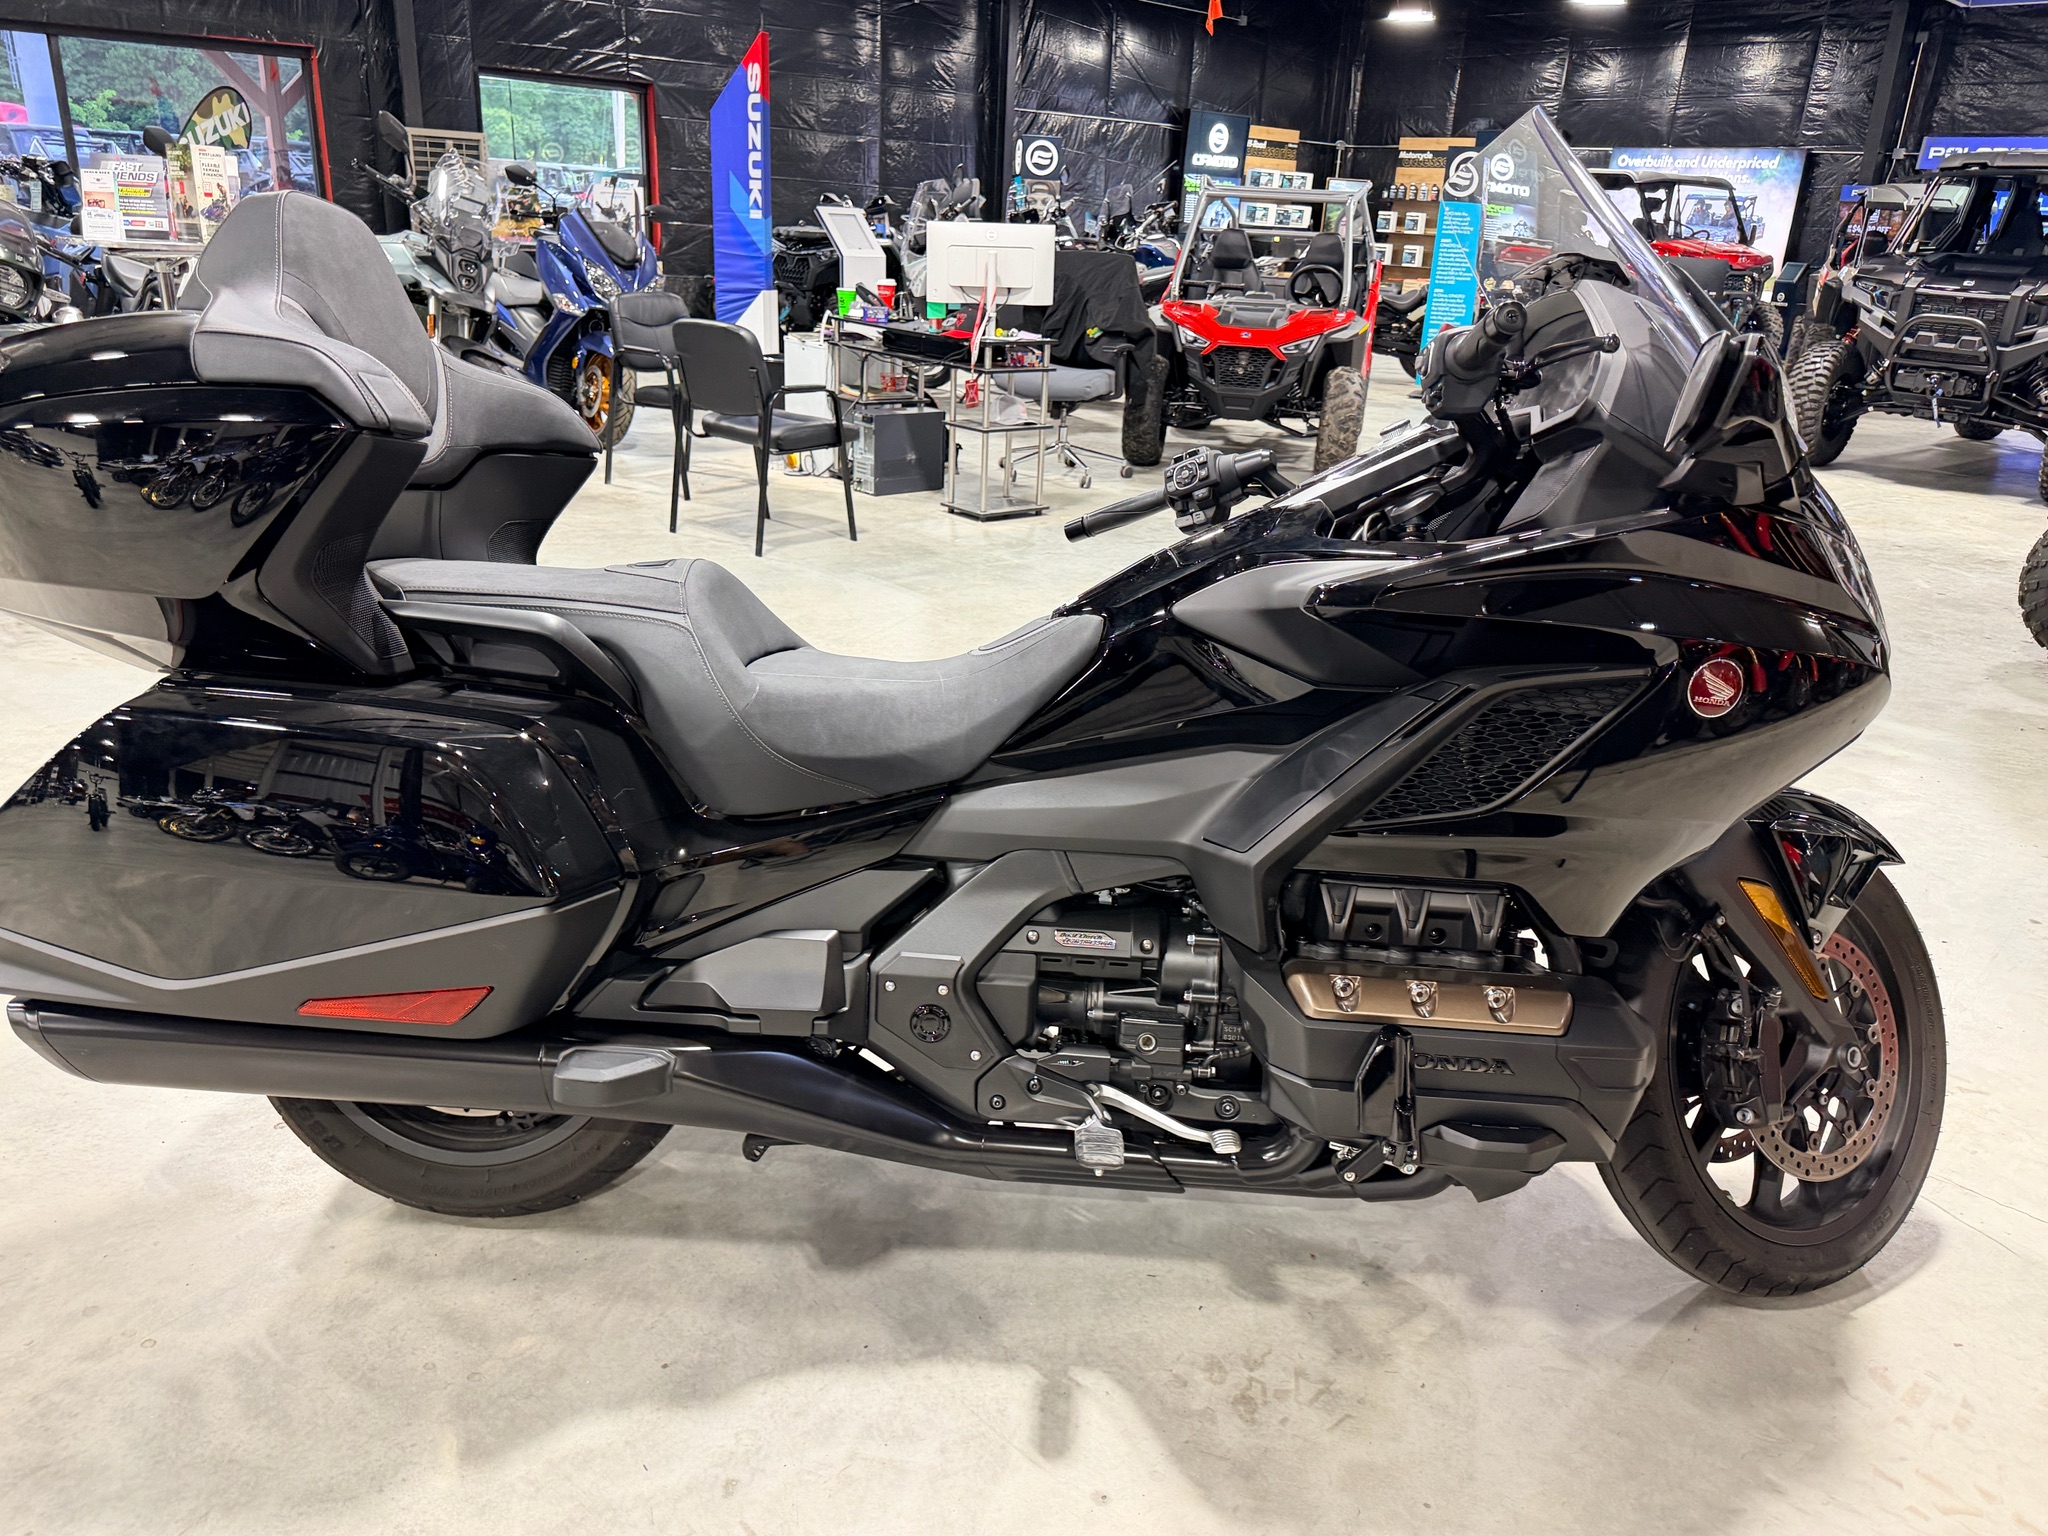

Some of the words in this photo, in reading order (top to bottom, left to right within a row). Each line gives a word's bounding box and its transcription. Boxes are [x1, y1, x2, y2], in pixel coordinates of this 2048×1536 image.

[179, 102, 251, 146] UZUKI
[747, 62, 763, 219] SUZUKI
[112, 161, 143, 172] FAST
[1617, 155, 1674, 168] Overbuilt
[1675, 156, 1700, 168] and
[1701, 154, 1781, 170] Underpriced
[117, 171, 155, 182] IENDS
[1921, 303, 1996, 320] POLARIS
[1693, 695, 1730, 707] HONDA
[1414, 1052, 1516, 1075] ONDA
